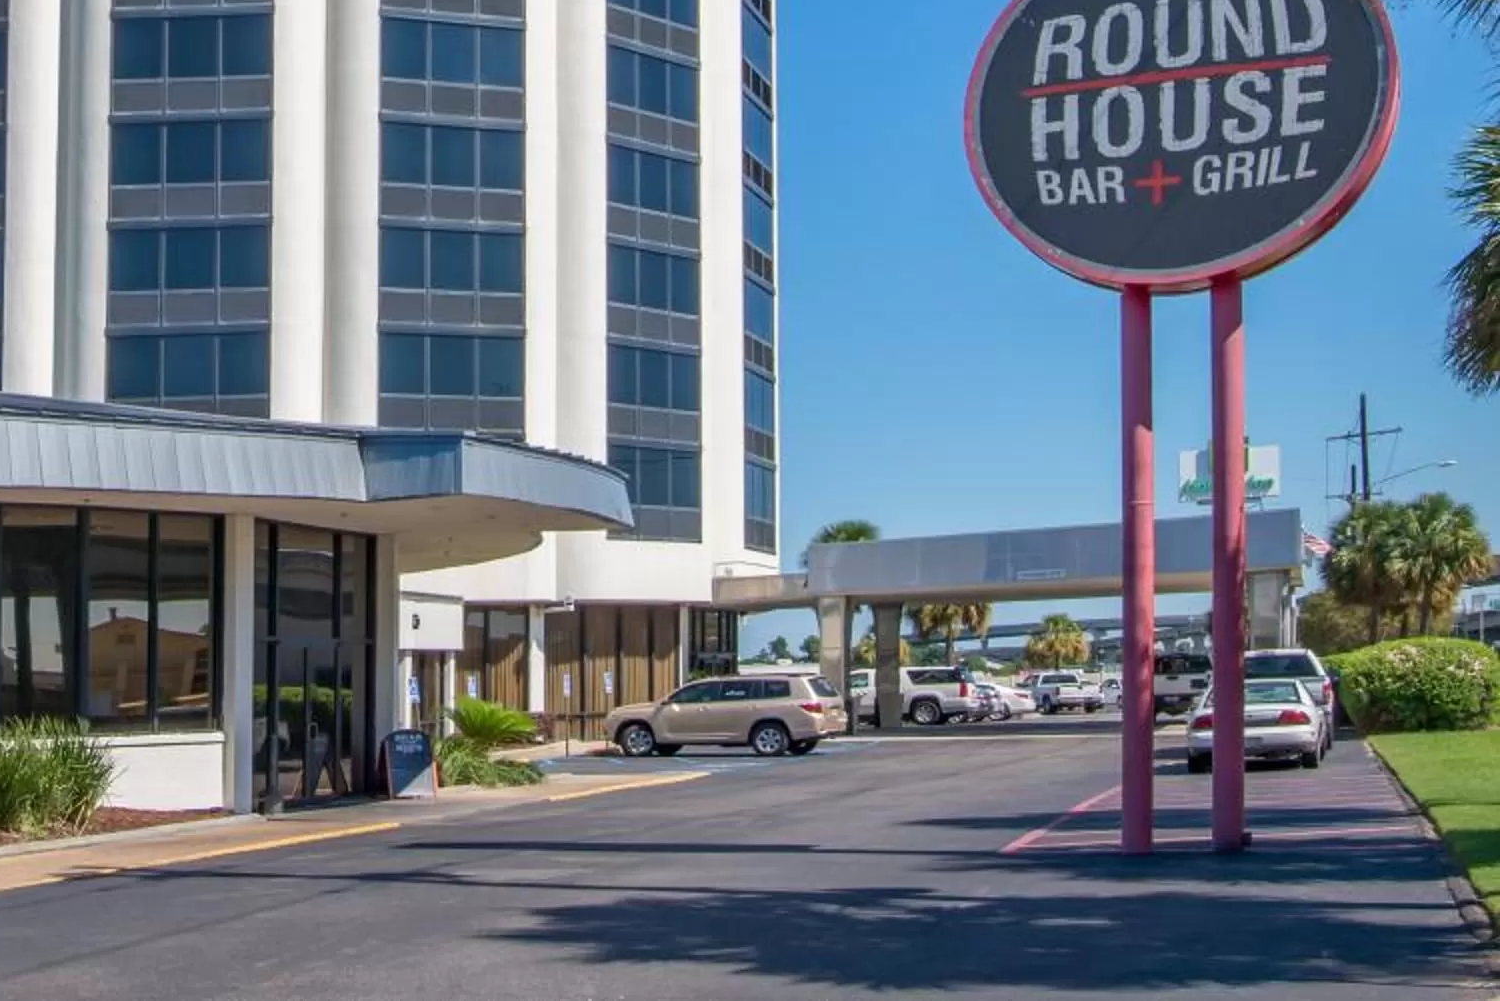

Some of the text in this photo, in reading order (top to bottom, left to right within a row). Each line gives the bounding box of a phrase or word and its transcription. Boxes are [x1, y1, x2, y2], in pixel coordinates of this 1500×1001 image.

[1030, 64, 1327, 163] HOUSE
[1035, 165, 1127, 207] BAR
[1192, 140, 1318, 196] GRILL
